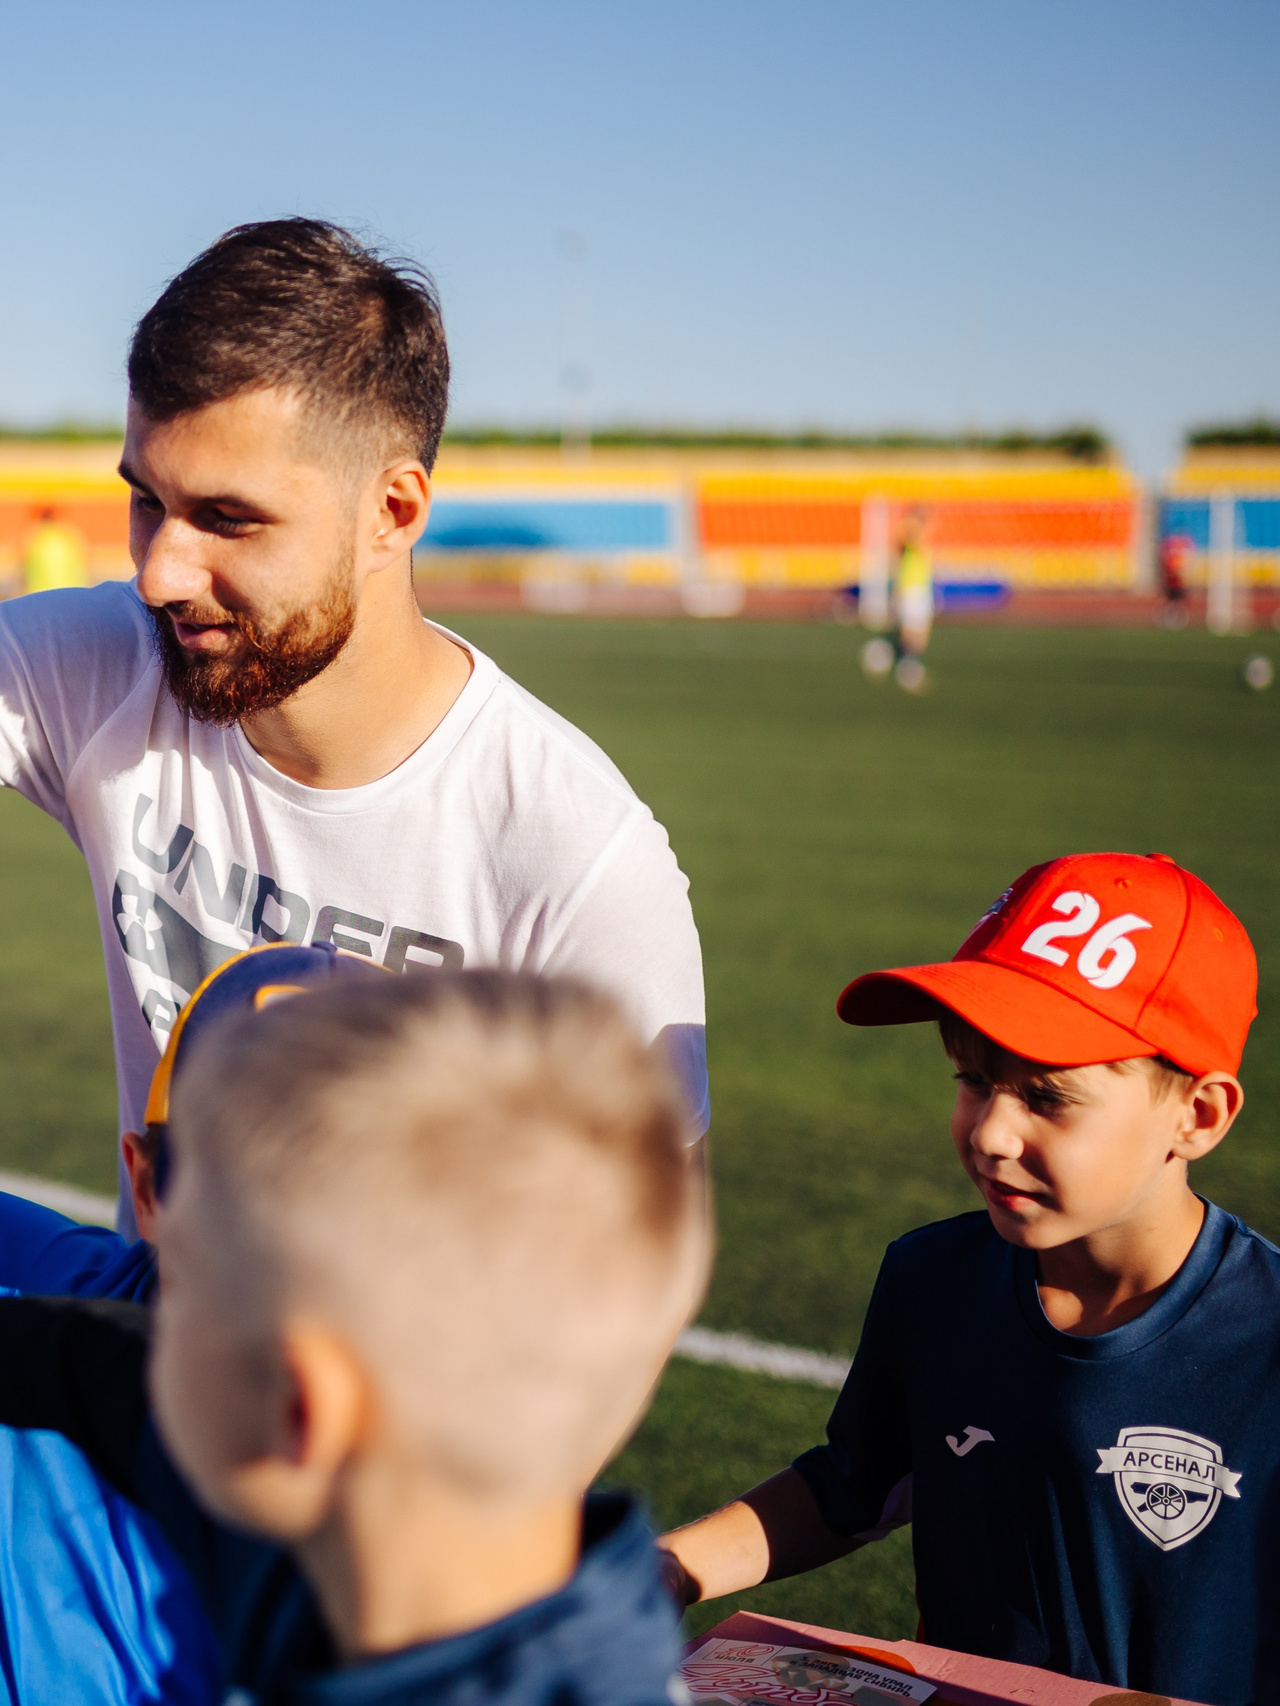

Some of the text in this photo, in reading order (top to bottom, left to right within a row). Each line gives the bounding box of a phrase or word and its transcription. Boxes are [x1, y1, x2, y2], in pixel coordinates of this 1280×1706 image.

[1020, 890, 1153, 989] 26
[1122, 1450, 1217, 1482] АРСЕНАЛ
[847, 1667, 880, 1680] ЗОНА
[883, 1676, 913, 1691] УРАЛ
[863, 1677, 911, 1697] СИБИРЬ
